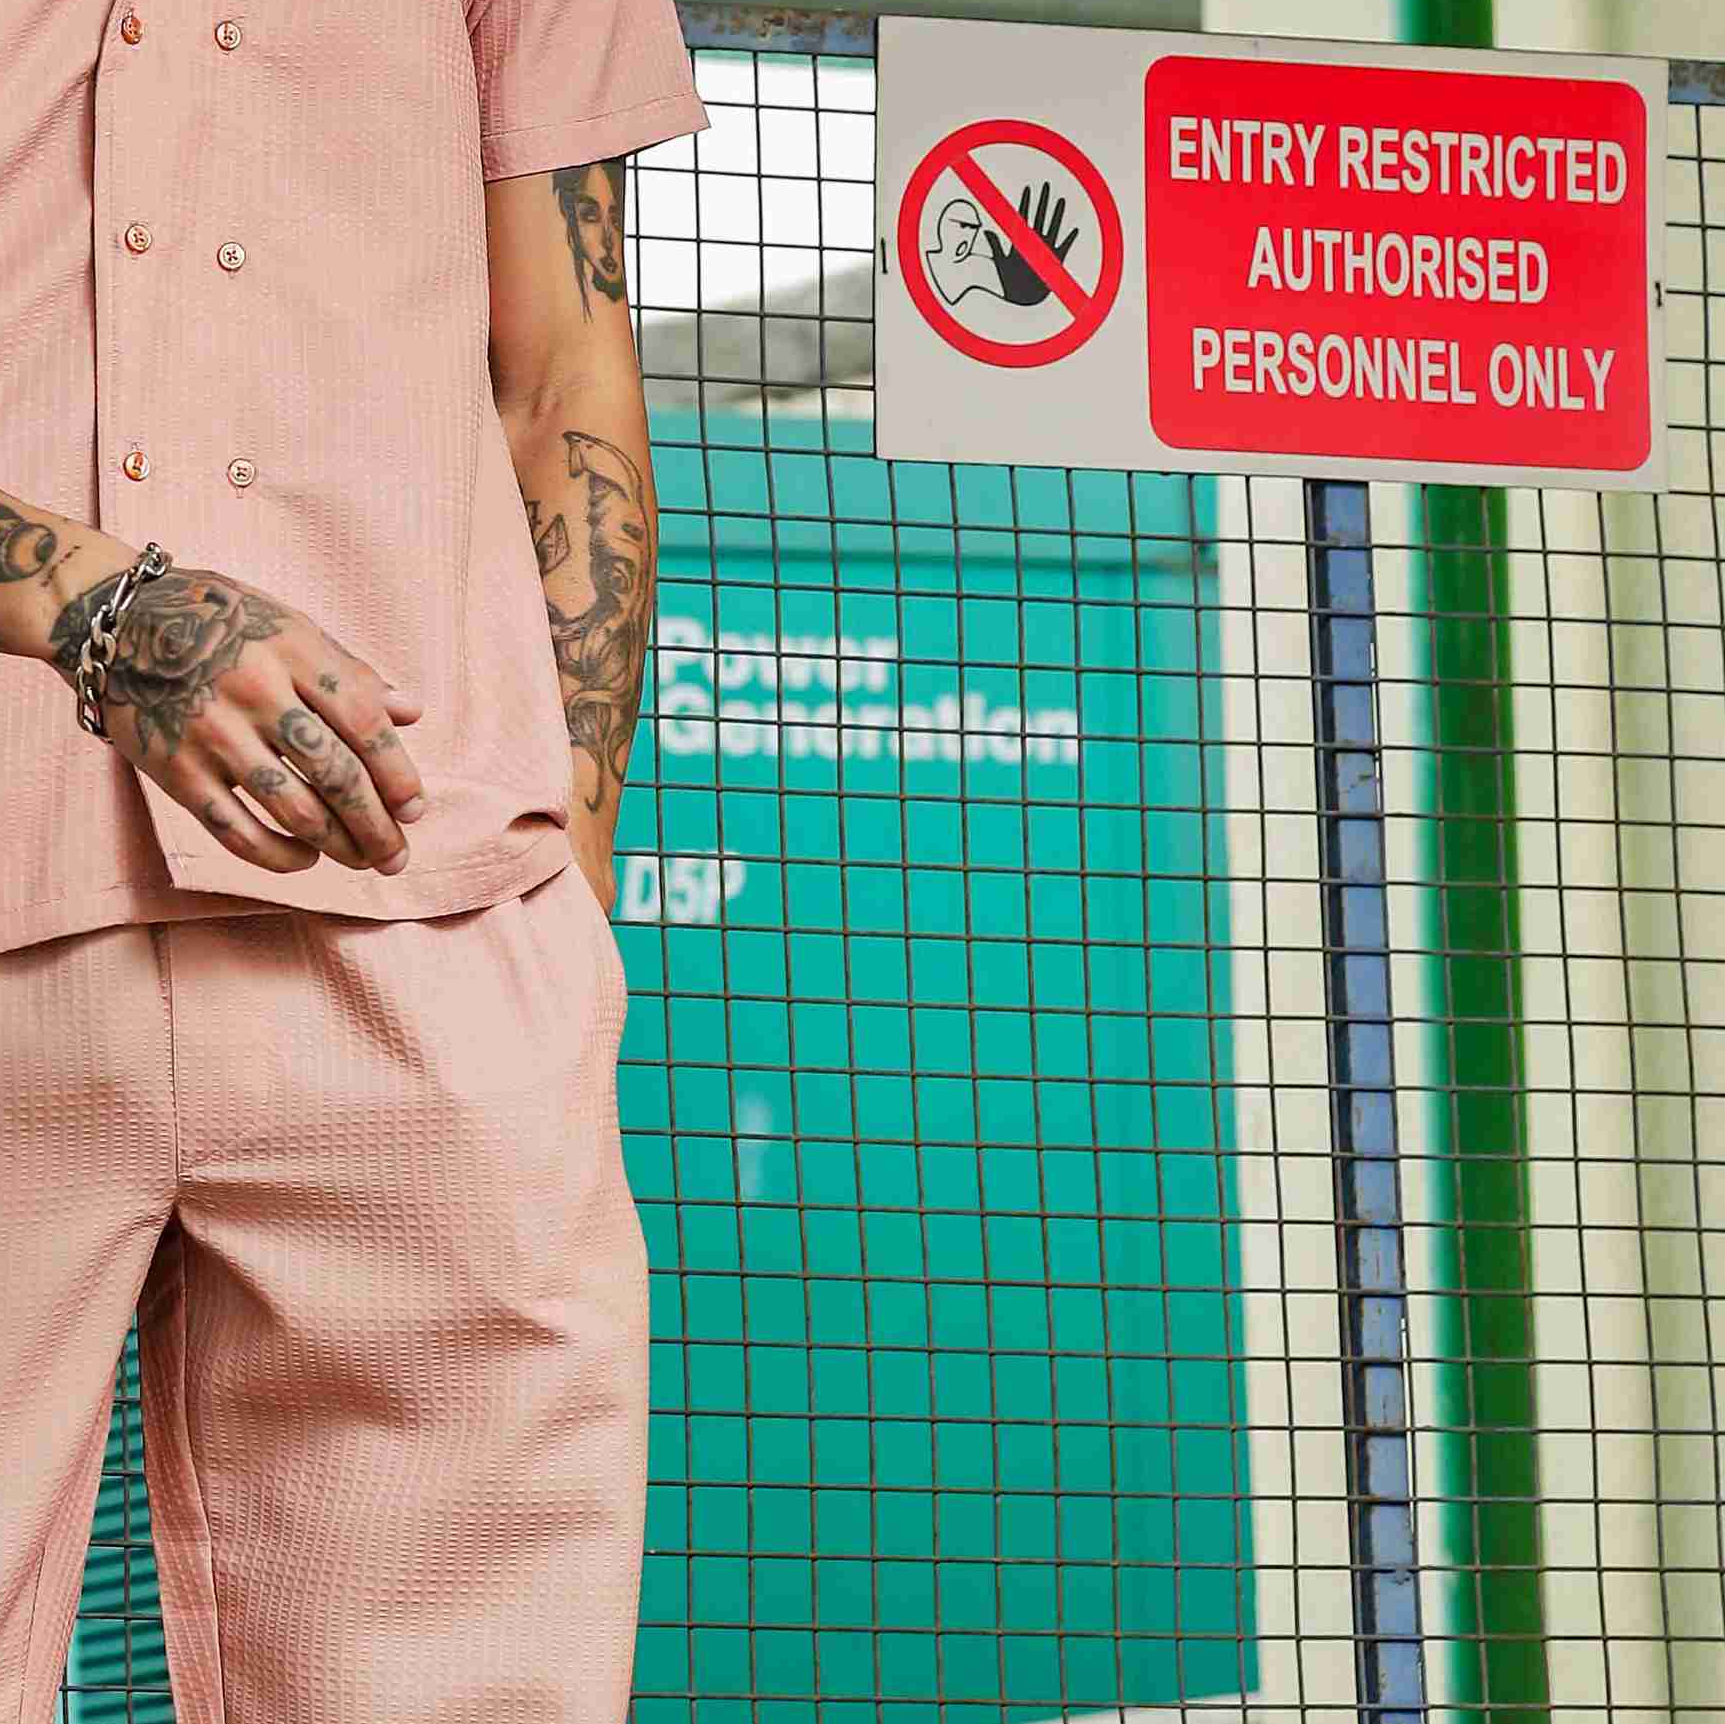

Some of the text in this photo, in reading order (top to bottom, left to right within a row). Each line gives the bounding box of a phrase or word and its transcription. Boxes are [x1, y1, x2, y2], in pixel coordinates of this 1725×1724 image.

[1169, 115, 1628, 205] ENTRY RESTRICTED
[1247, 226, 1549, 304] AUTHORISED
[1191, 327, 1616, 412] PERSONNEL ONLY
[656, 616, 899, 691] Power
[656, 683, 1082, 765] Generation
